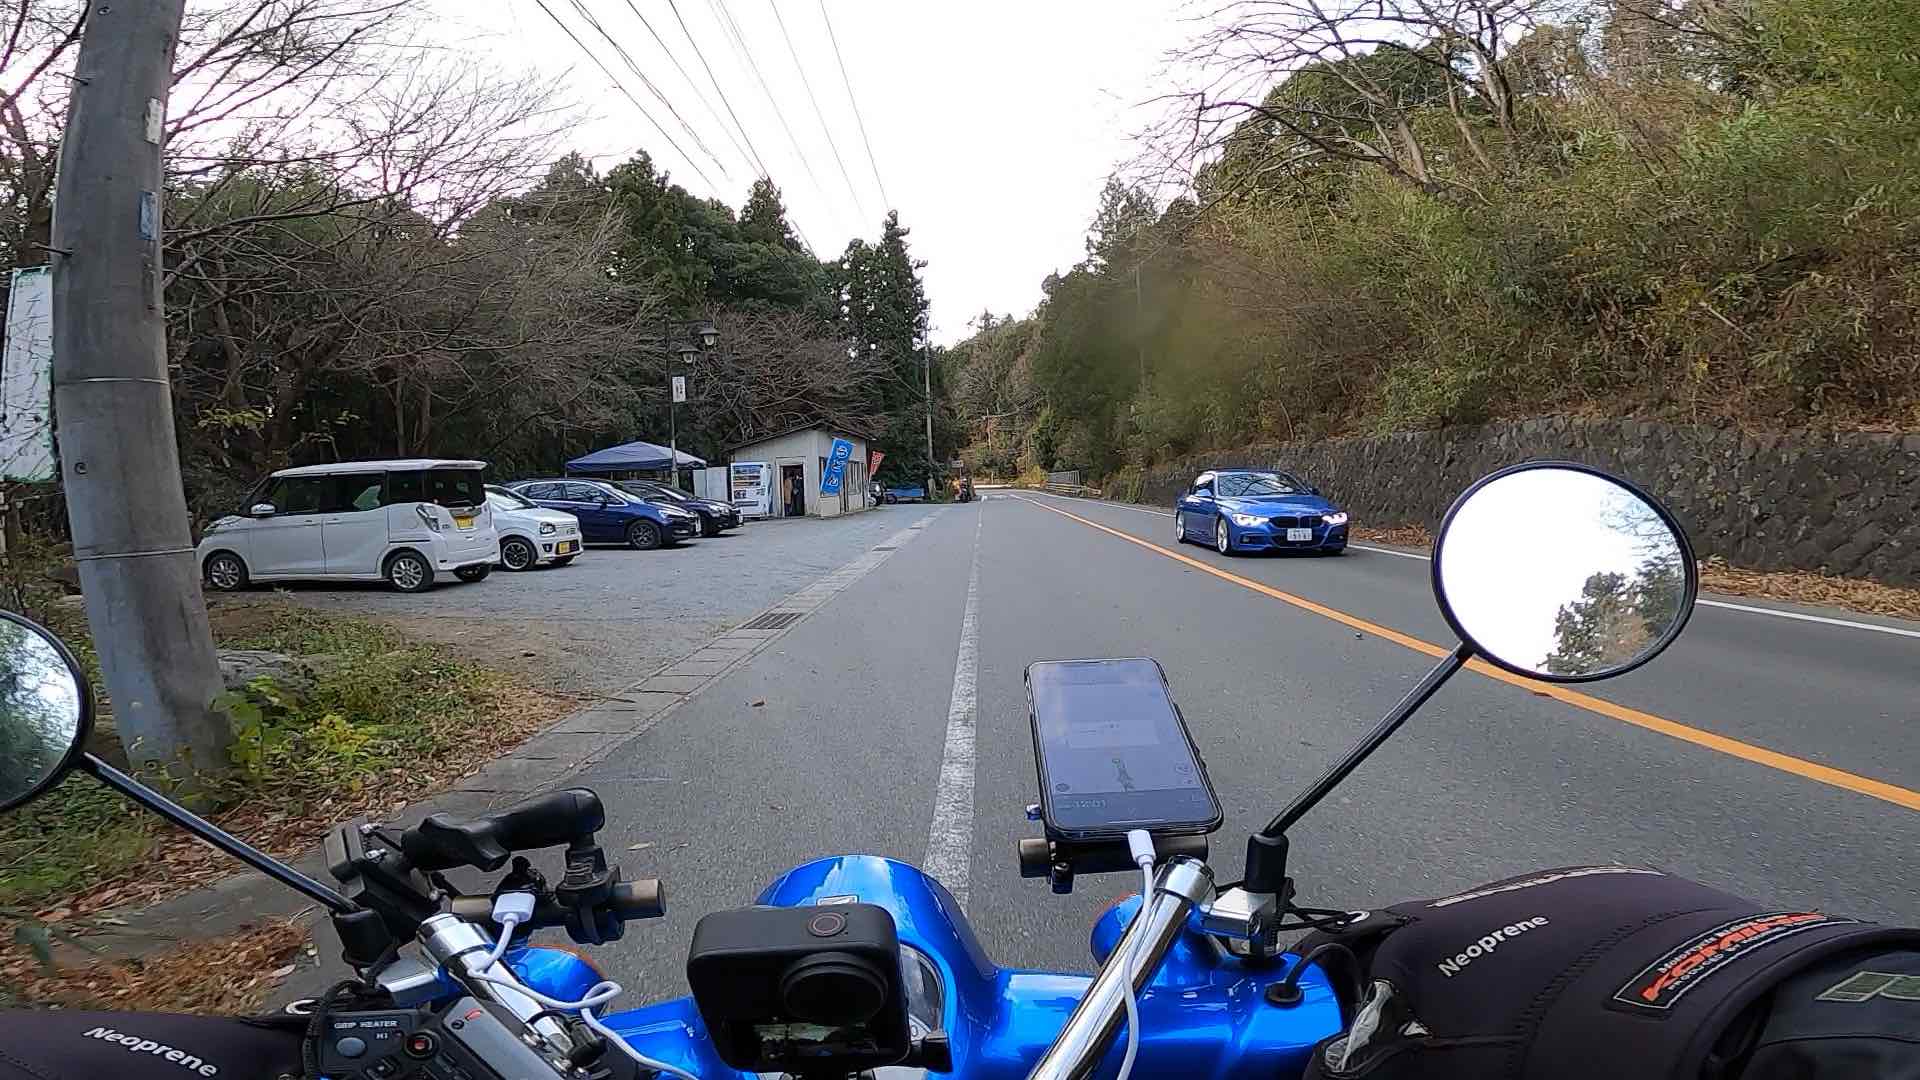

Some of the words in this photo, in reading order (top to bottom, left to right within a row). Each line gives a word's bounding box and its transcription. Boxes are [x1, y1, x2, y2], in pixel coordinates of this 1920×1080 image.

[1437, 916, 1549, 977] Neoprene
[333, 1021, 357, 1030] GRIP
[359, 1020, 399, 1029] HEATER
[82, 1027, 217, 1077] Neoprene
